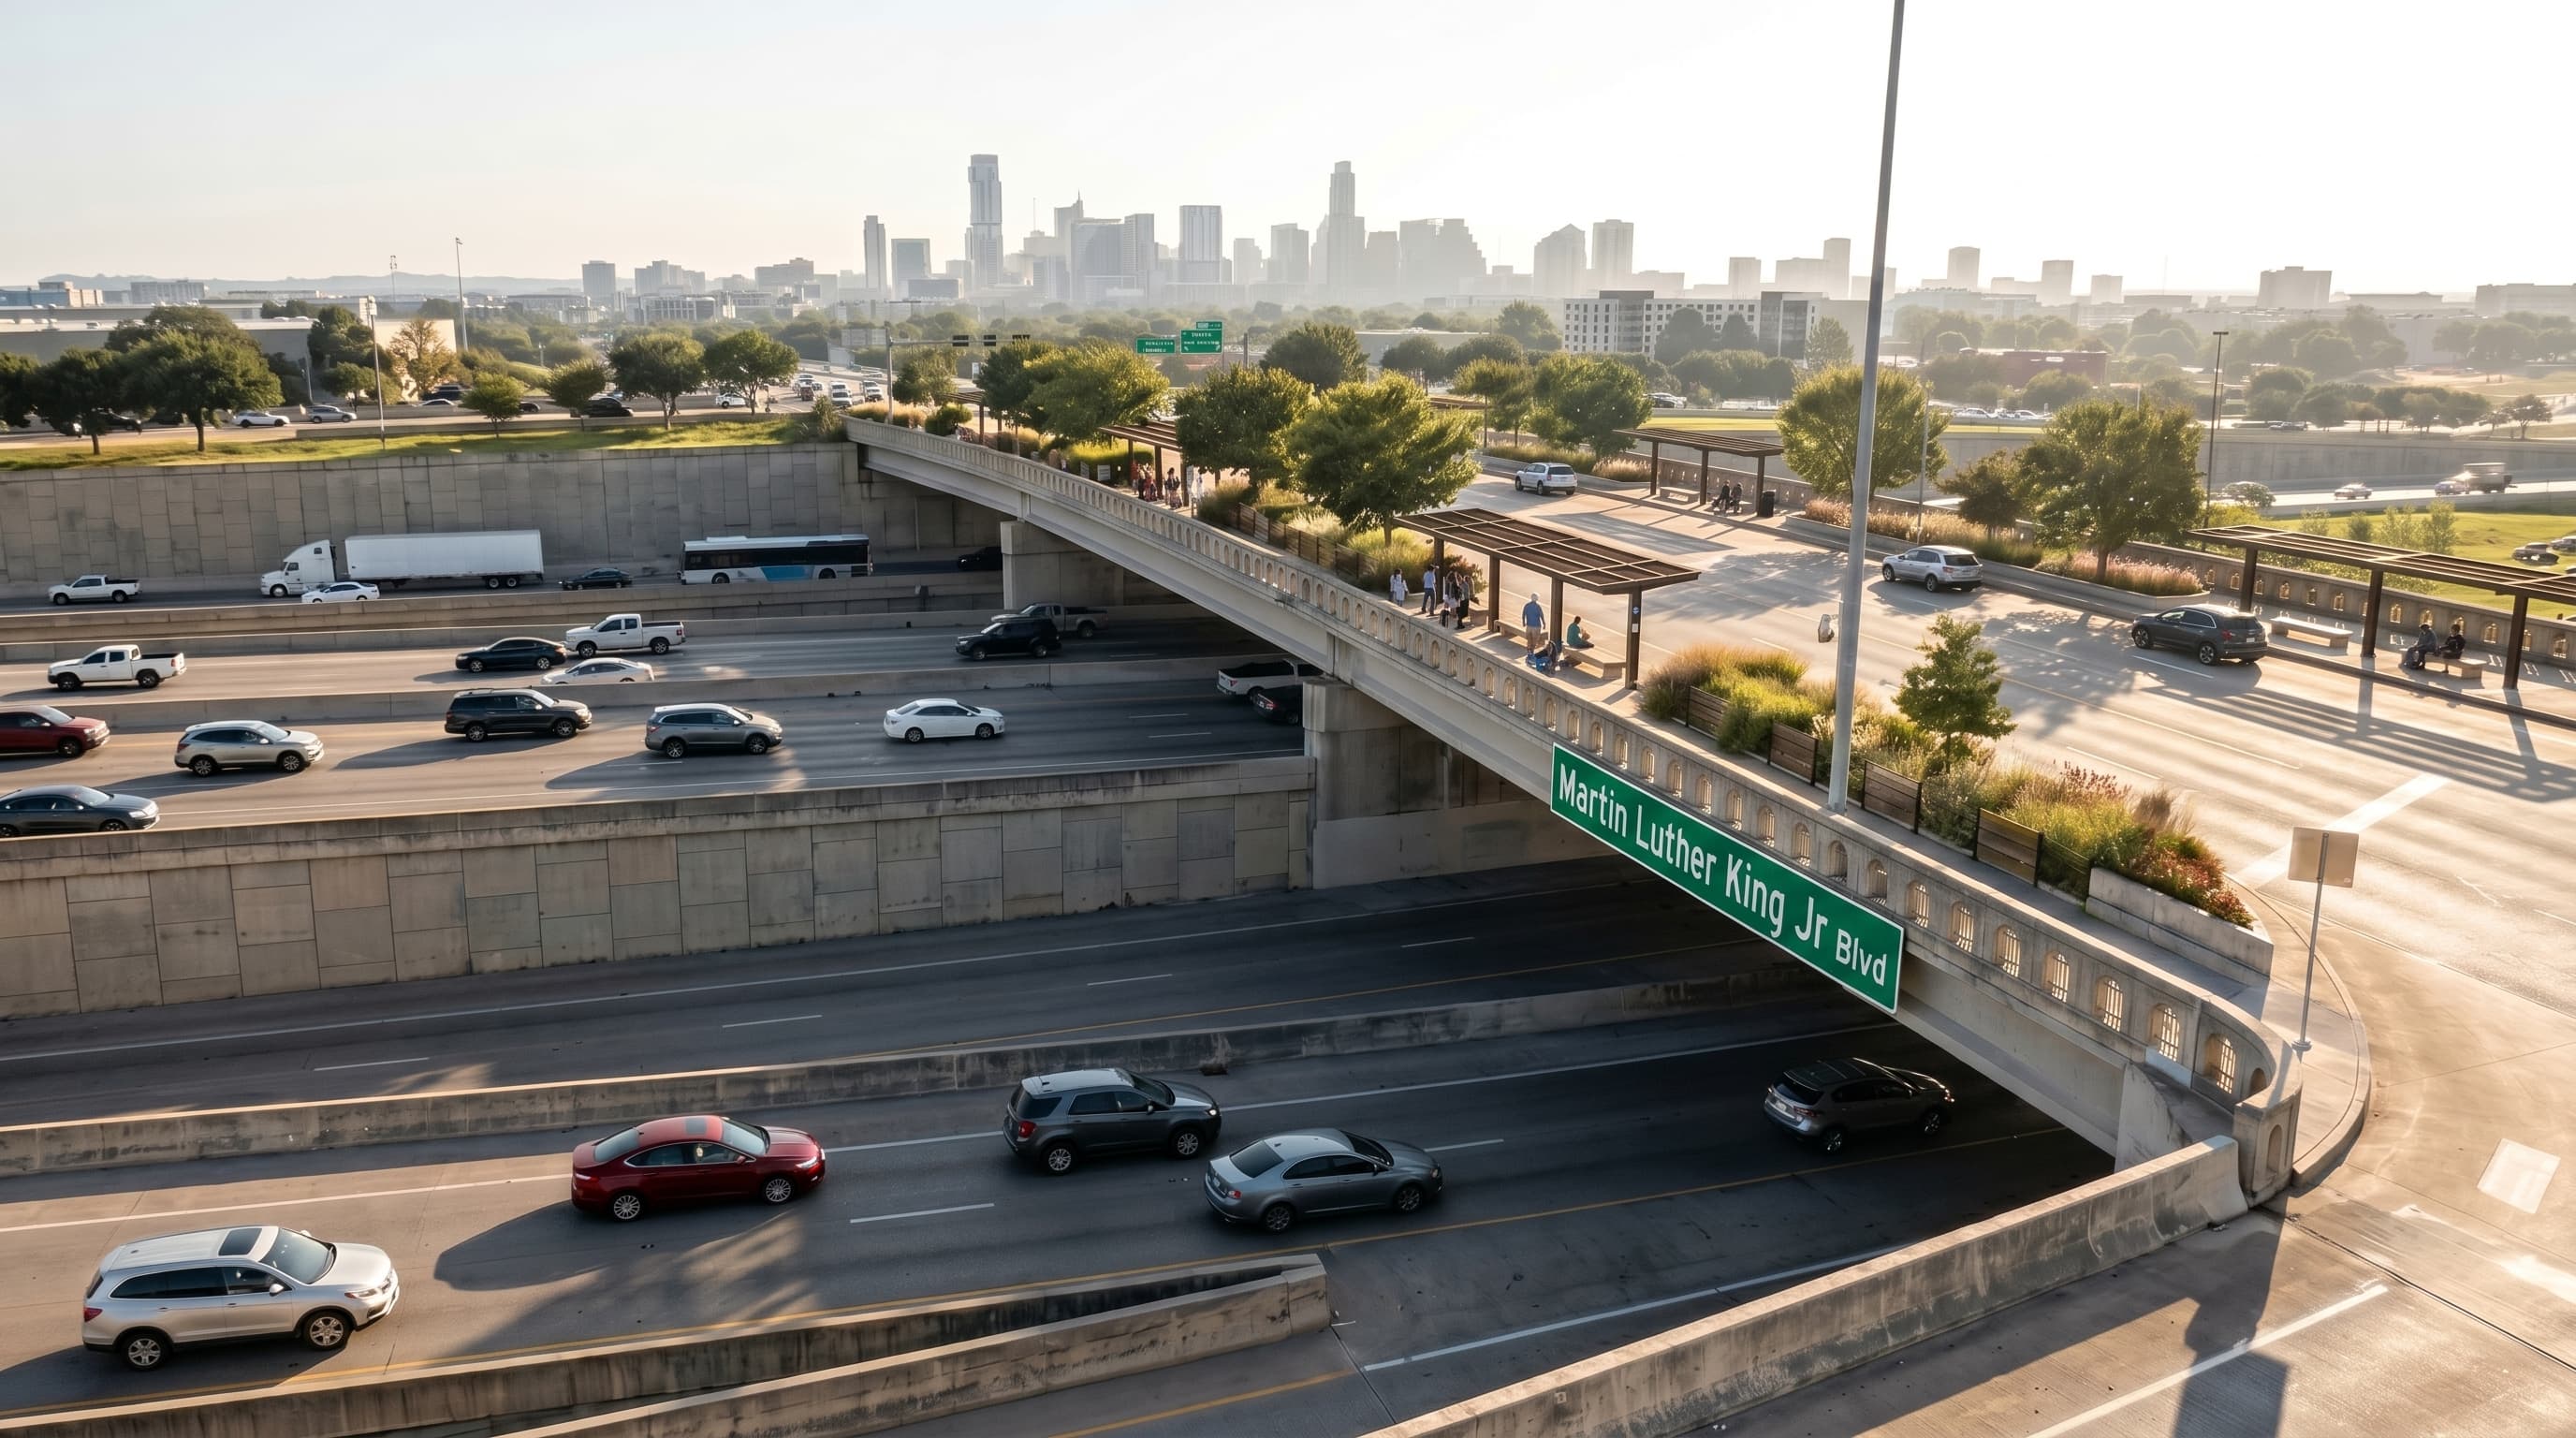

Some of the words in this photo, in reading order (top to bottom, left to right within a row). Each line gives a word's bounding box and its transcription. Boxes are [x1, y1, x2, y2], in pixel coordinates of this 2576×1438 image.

[1559, 763, 1628, 838] Martin
[1635, 804, 1717, 886] Luther
[1725, 853, 1785, 938] King
[1794, 896, 1828, 949] Jr
[1836, 928, 1887, 987] Blvd
